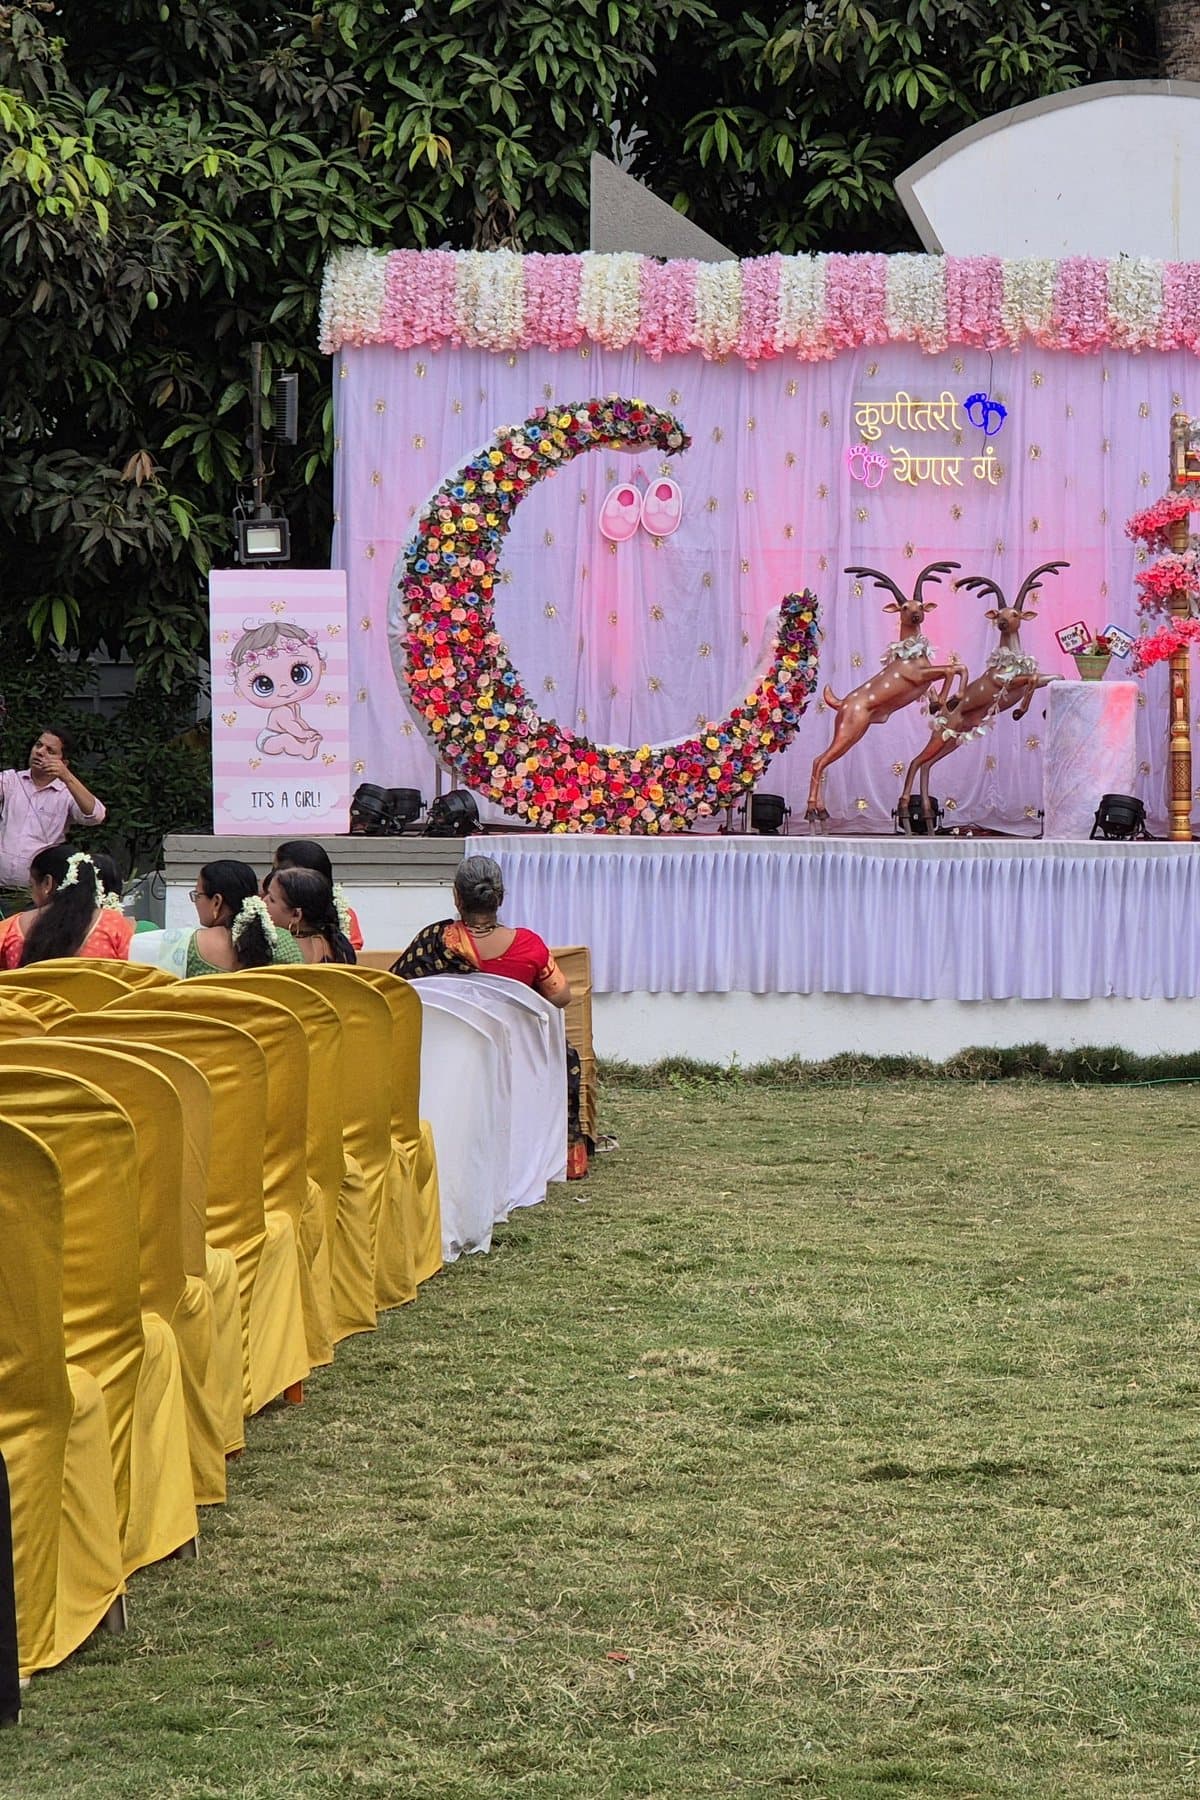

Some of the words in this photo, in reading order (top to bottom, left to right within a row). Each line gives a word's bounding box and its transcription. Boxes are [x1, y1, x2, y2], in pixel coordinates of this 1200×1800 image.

[854, 391, 963, 441] कुणीतरी
[889, 445, 964, 487] येणार
[970, 446, 998, 486] गं
[251, 791, 275, 808] IT'S
[281, 791, 289, 808] A
[295, 790, 321, 808] GIRL!
